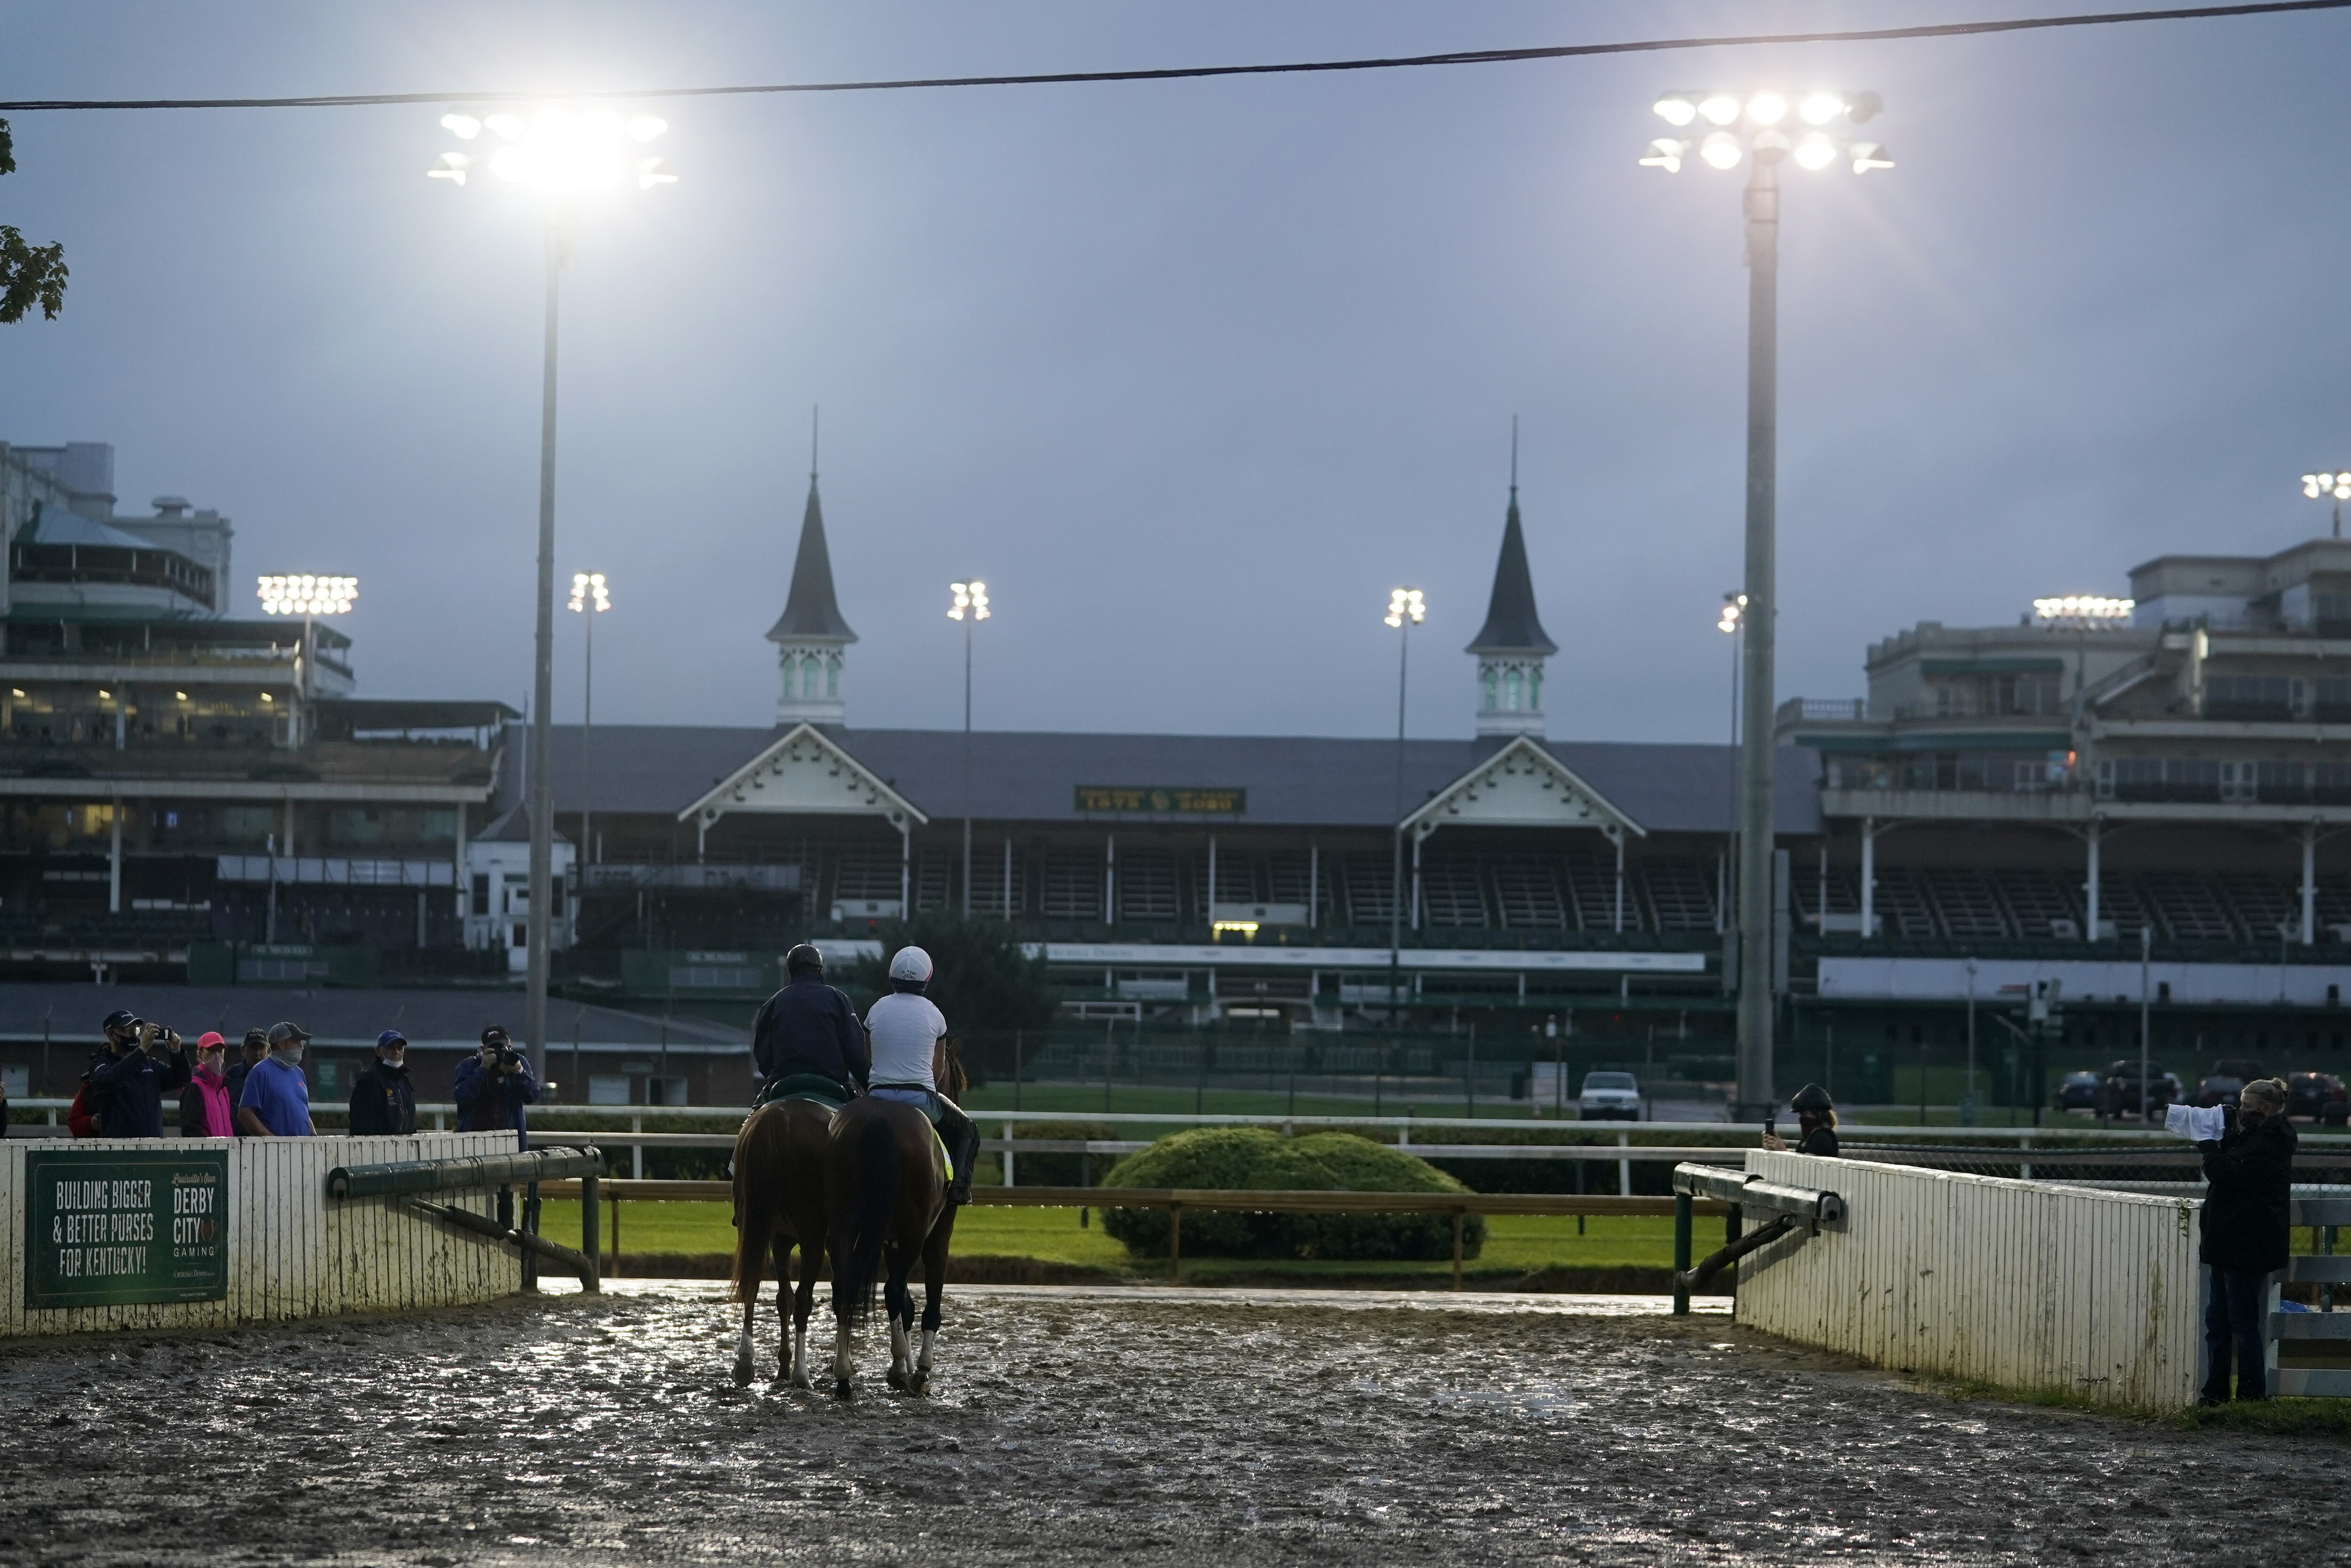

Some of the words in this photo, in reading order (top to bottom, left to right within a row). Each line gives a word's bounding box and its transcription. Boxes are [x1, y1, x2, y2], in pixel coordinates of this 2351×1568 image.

[56, 1181, 108, 1210] BUILDING
[112, 1180, 151, 1209] BIGGER
[174, 1187, 214, 1214] DERBY
[53, 1215, 62, 1244] &
[67, 1214, 107, 1243] BETTER
[111, 1213, 153, 1242] PURSES
[174, 1217, 201, 1244] CITY
[60, 1248, 81, 1277] FOR
[86, 1246, 146, 1276] KENTUCKY!
[174, 1246, 214, 1257] GAMING
